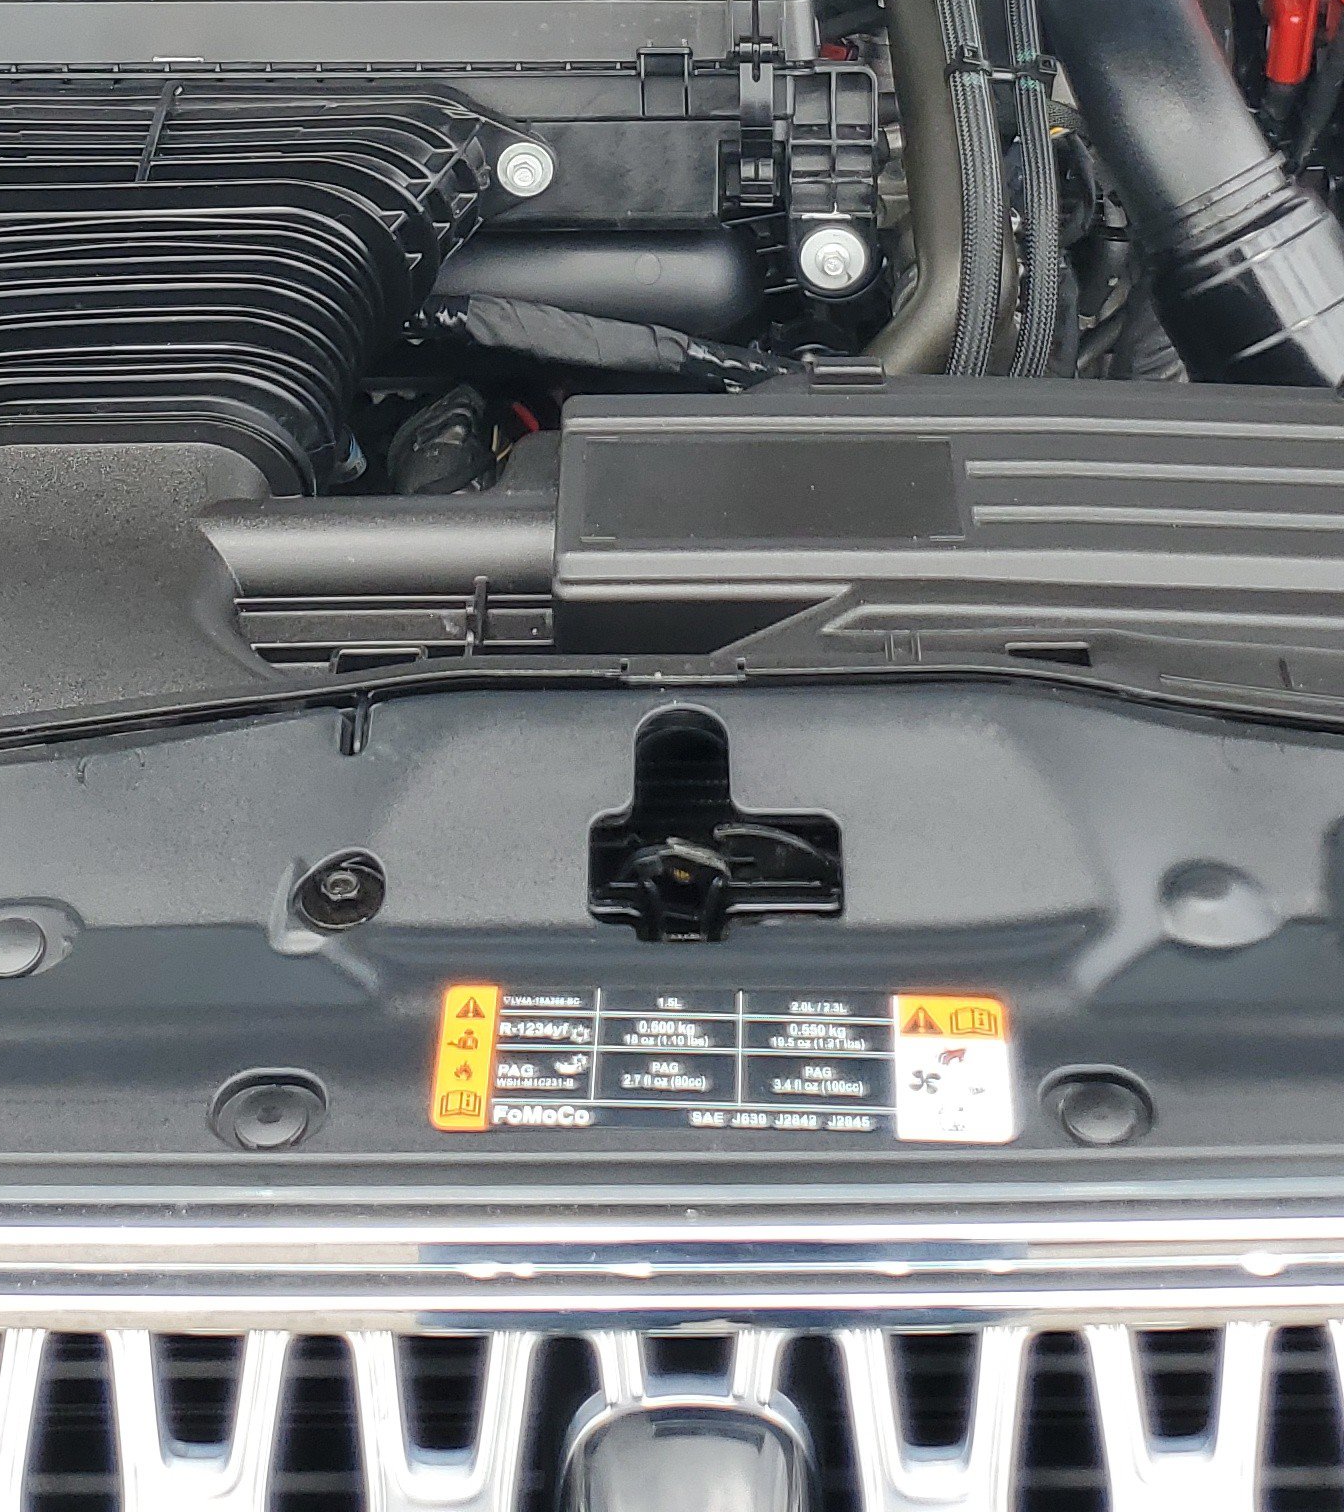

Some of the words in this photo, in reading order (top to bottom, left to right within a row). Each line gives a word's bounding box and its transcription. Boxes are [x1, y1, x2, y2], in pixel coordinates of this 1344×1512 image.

[500, 1022, 570, 1039] R-1234yf
[677, 1020, 696, 1038] kg
[828, 1024, 847, 1040] kg
[640, 1036, 655, 1046] oz
[797, 1038, 811, 1048] oz
[498, 1063, 535, 1078] PAG
[652, 1061, 680, 1075] PAG
[804, 1066, 833, 1079] PAG
[623, 1073, 642, 1085] 2.7
[654, 1076, 669, 1087] oz
[804, 1082, 819, 1091] oz
[493, 1105, 591, 1126] FoMoCo
[692, 1111, 725, 1125] SAE
